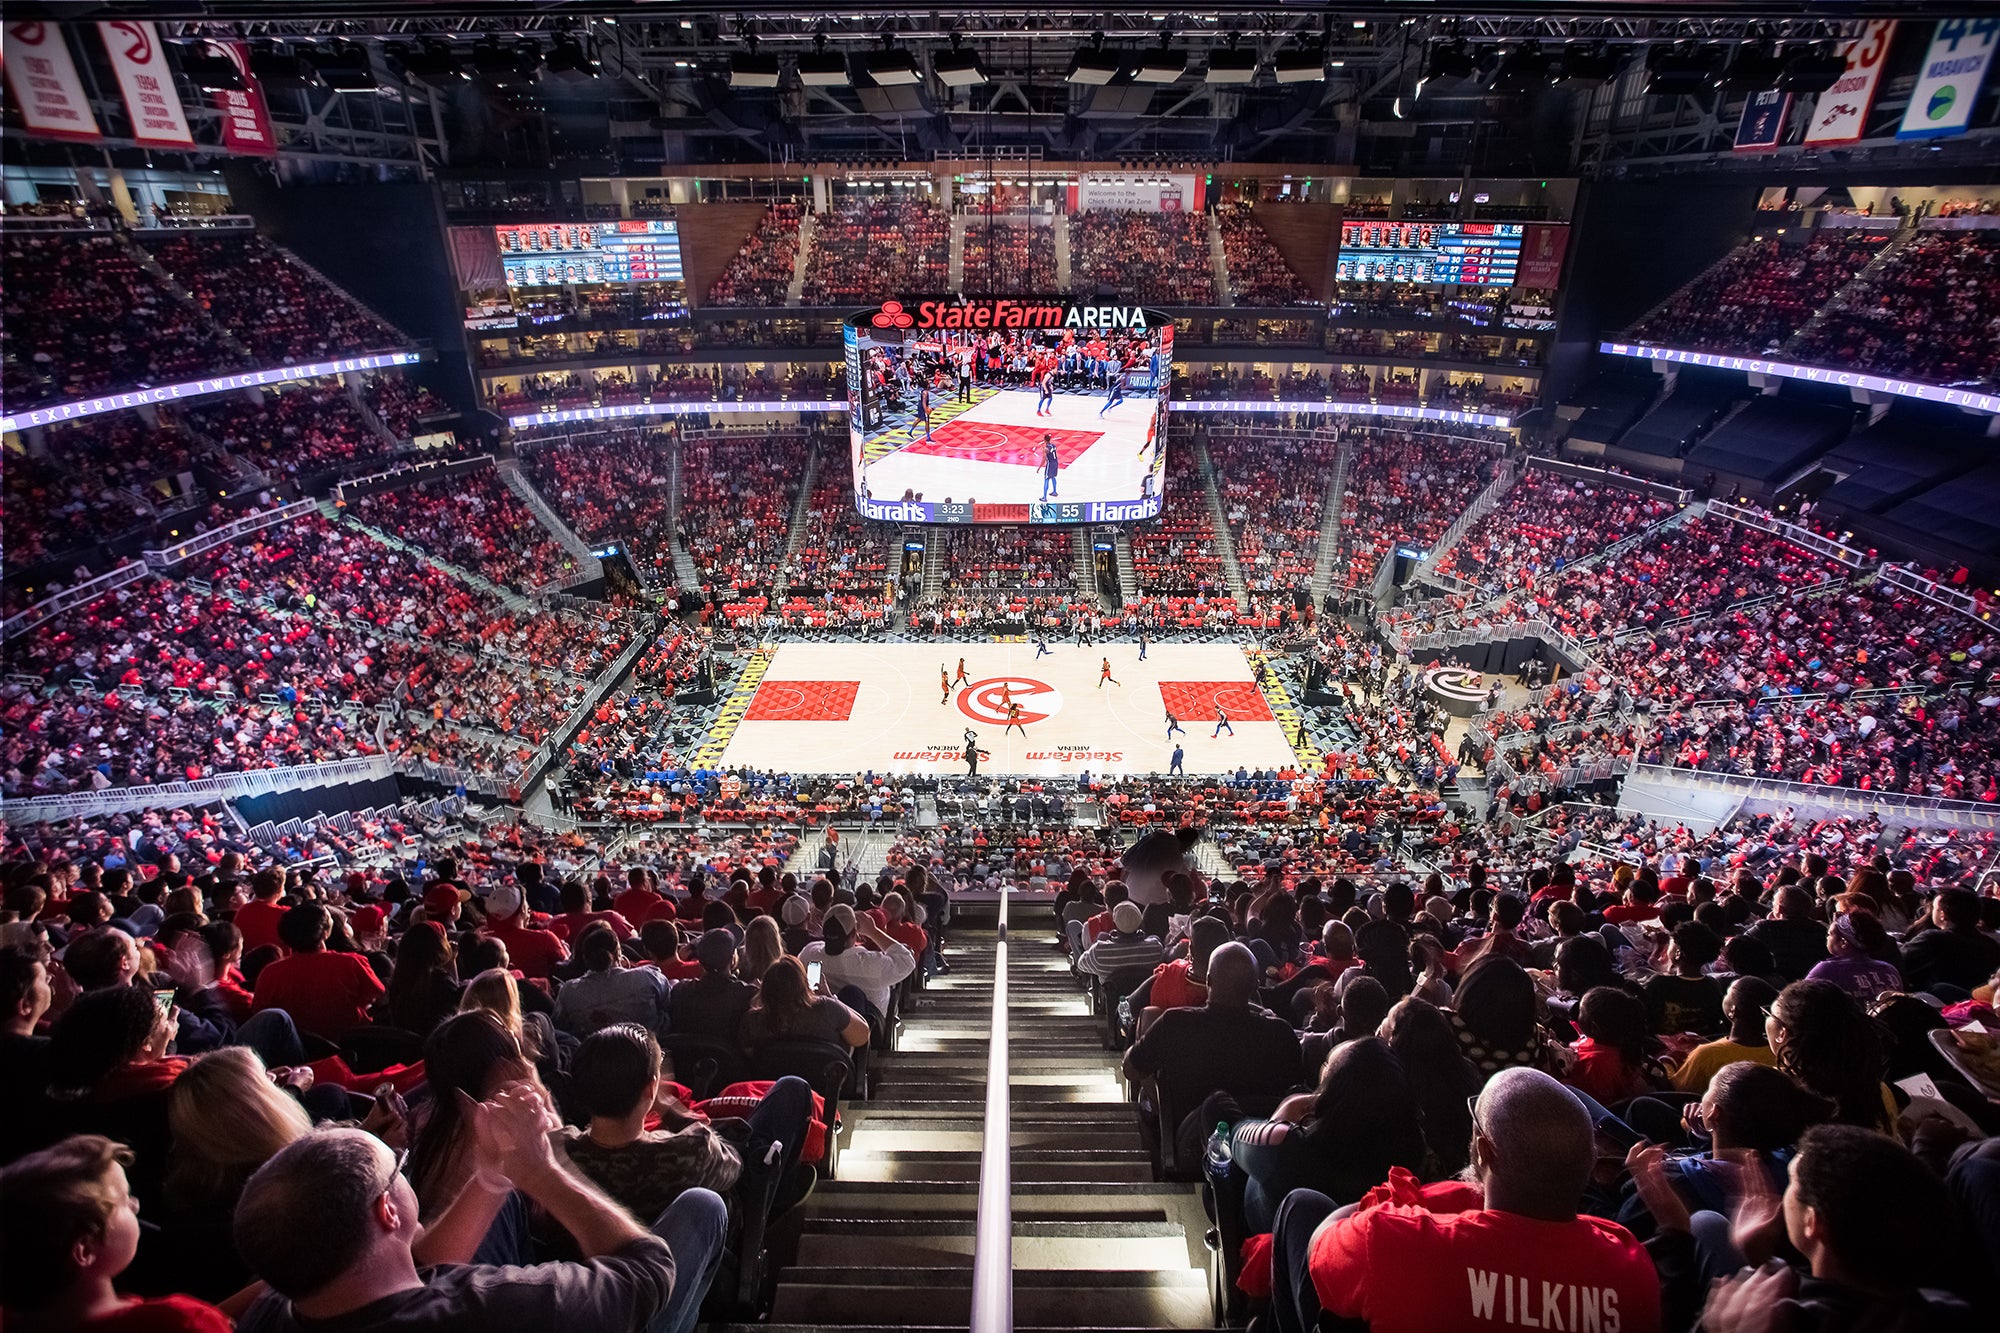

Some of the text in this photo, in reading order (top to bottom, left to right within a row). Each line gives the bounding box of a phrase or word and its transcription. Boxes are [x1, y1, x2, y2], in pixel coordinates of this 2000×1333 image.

[1831, 76, 1868, 95] HUDSON
[1464, 224, 1494, 233] HAWKS
[1512, 225, 1523, 233] 55
[1065, 306, 1147, 328] ARENA
[1637, 347, 1775, 373] EXPERIENCE
[1792, 367, 1866, 387] TWICE
[1884, 380, 1925, 397] THE
[30, 387, 180, 425] EXPERIENCE
[196, 373, 266, 393] TWICE
[280, 365, 318, 379] THE
[536, 405, 655, 424] EXPERIENCE
[669, 403, 723, 412] TWICE
[737, 402, 766, 411] THE
[1199, 403, 1309, 411] EXPERIENCE
[1324, 403, 1378, 414] TWICE
[1393, 407, 1424, 417] THE
[942, 504, 964, 514] 3:23
[976, 506, 1028, 519] HAWKS
[1062, 505, 1079, 517] 55
[690, 696, 751, 771] ATLANTA
[1467, 1267, 1620, 1333] WILKINS
